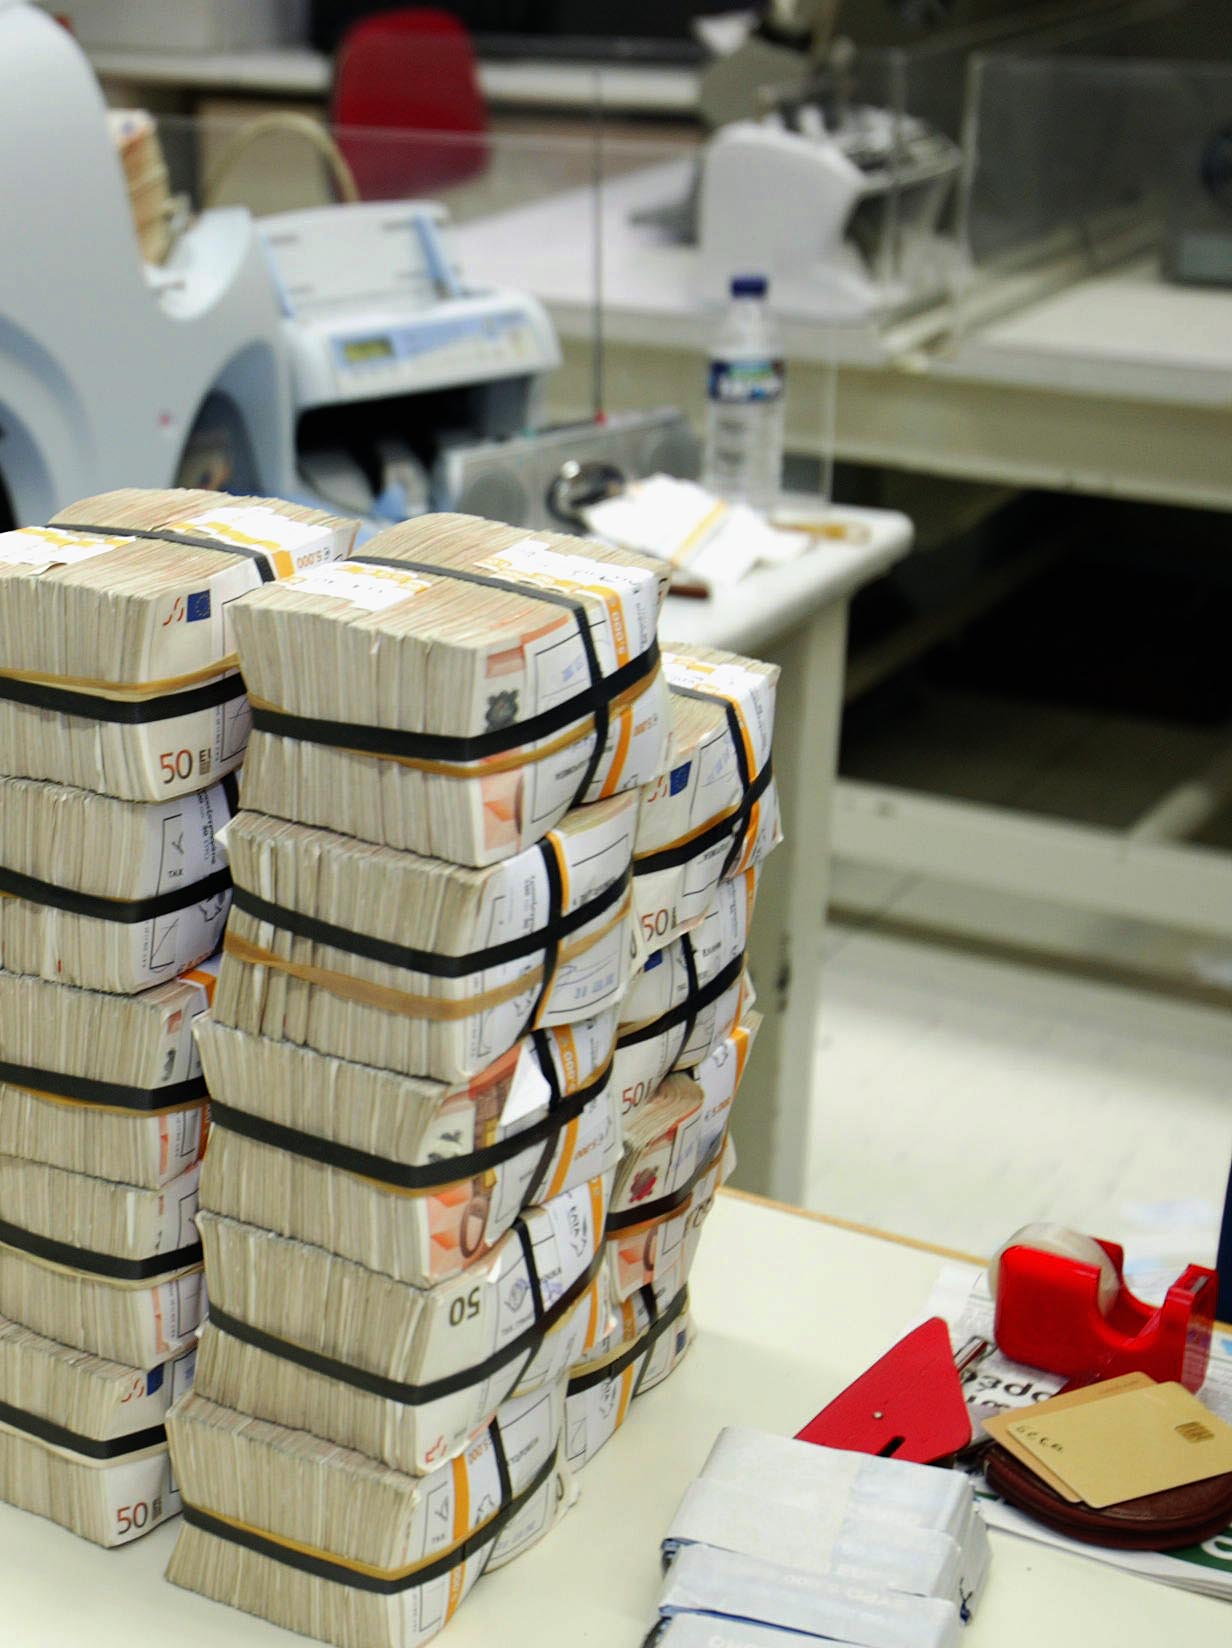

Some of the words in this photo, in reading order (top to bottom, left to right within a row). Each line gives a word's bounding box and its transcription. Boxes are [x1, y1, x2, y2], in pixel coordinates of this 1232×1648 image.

[159, 748, 193, 784] 50
[641, 908, 669, 942] 50
[621, 1082, 645, 1116] 50
[449, 1286, 481, 1328] 50
[117, 1501, 149, 1535] 50
